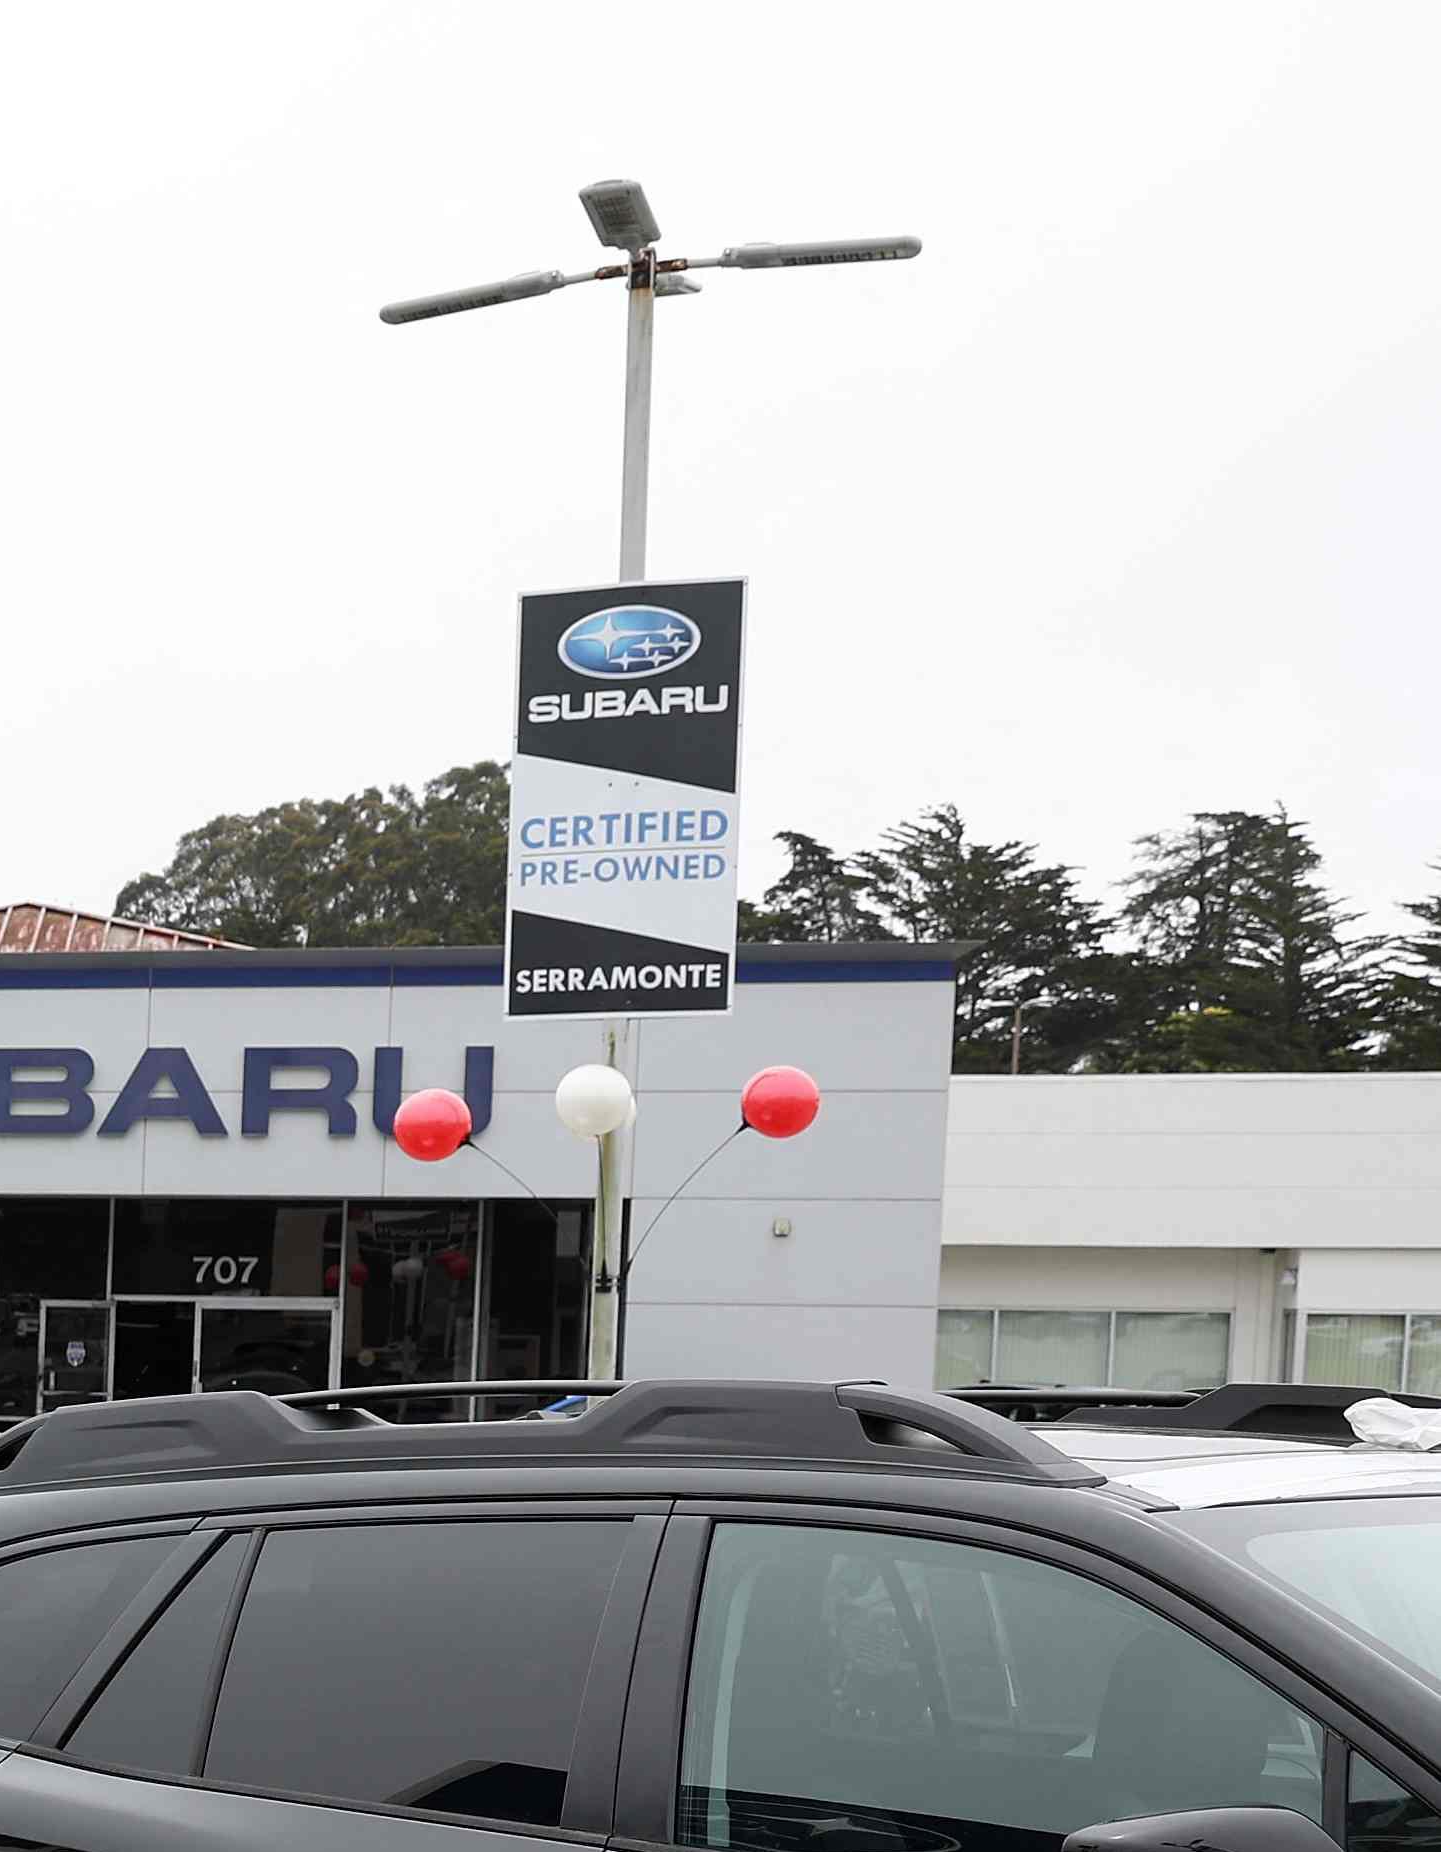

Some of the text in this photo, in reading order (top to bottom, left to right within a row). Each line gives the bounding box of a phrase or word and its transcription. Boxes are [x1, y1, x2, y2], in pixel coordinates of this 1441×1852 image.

[528, 685, 729, 722] SUBARU
[520, 810, 729, 849] CERTIFIED
[519, 855, 726, 886] PRE-OWNED
[515, 964, 722, 993] SERRAMONTE
[192, 1256, 259, 1285] 707
